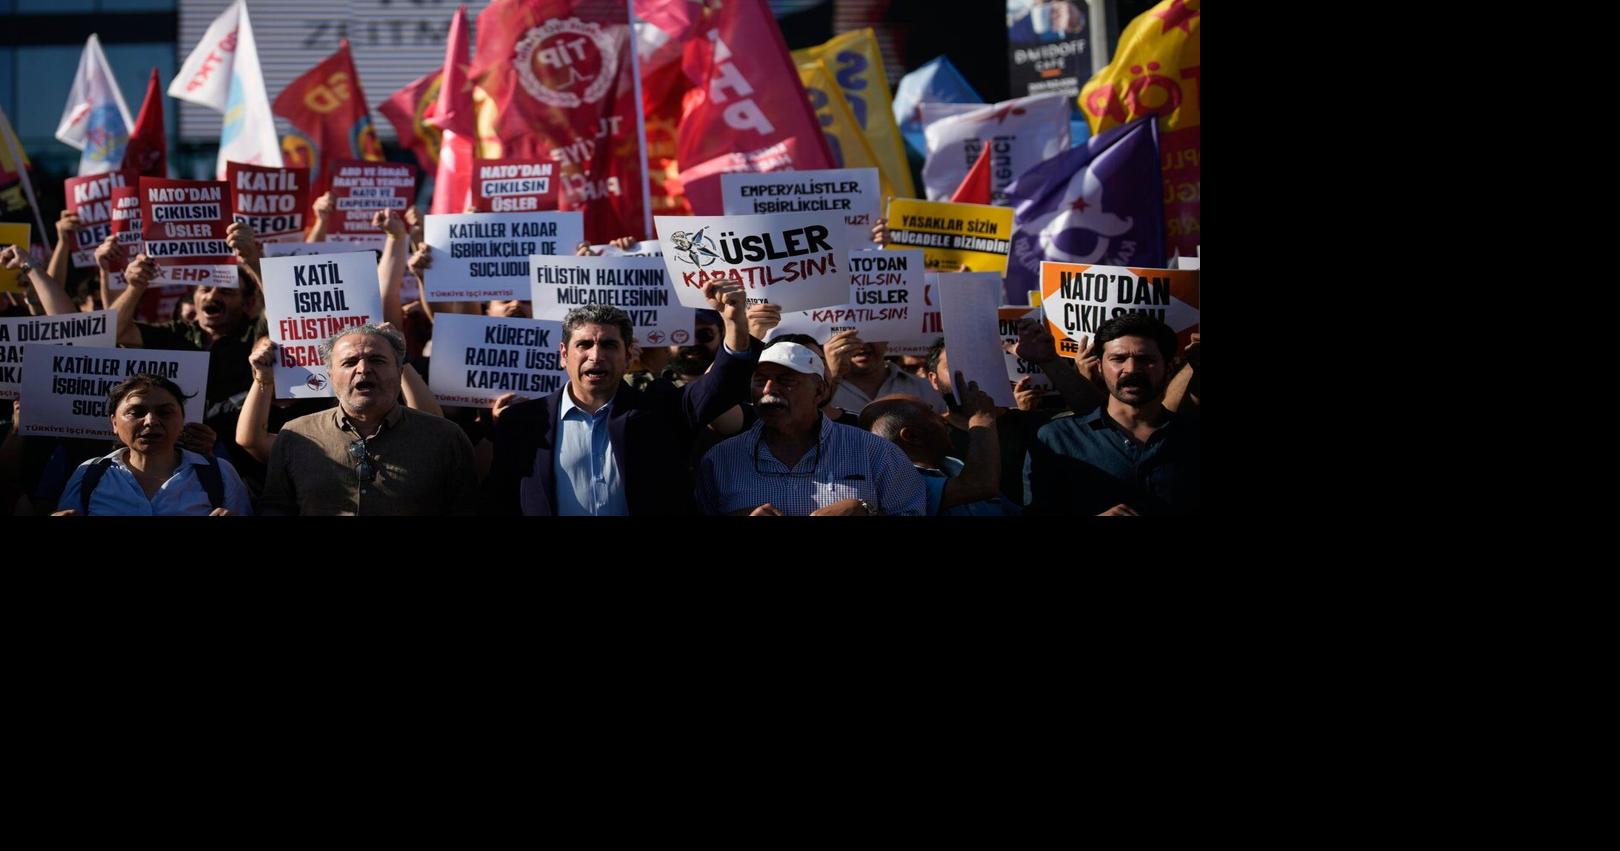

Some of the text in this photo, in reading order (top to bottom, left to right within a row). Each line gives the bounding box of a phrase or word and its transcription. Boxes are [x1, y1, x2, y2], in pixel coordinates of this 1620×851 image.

[236, 170, 298, 192] KATİL
[480, 164, 552, 179] NATO'DAN
[148, 186, 222, 203] NATO'DAN
[485, 180, 545, 195] ÇIKILSIN
[741, 179, 862, 197] EMPERYALİSTLER,
[77, 201, 112, 224] NAT
[238, 193, 296, 213] NATO
[492, 197, 538, 212] ÜSLER
[154, 205, 219, 222] ÇIKILSIN
[165, 223, 212, 238] ÜSLER
[450, 221, 557, 239] KATİLLER KADAR
[903, 215, 998, 235] YASAKLAR SİZİN
[451, 240, 557, 259] İŞBİRLİKÇİLER DE
[720, 225, 833, 265] ÜSLER
[891, 230, 951, 247] MÜCADELE
[954, 235, 1009, 253] BİZİMDİR!
[171, 268, 210, 281] EHP
[294, 261, 343, 286] KATİL
[682, 253, 838, 290] KAPATILSIN!
[848, 257, 907, 273] TO'DAN
[537, 265, 664, 286] FİLİSTİN HALKININ
[557, 286, 668, 307] MÜCADELESİNİN
[856, 284, 908, 305] ÜSLER
[1060, 271, 1171, 306] NATO'DAN
[294, 287, 349, 313] İSRAİL
[745, 297, 769, 305] ATO'YA
[812, 306, 908, 323] KAPATILSIN!
[18, 314, 106, 342] DÜZENİNİZİ
[485, 324, 551, 348] KÜRECİK
[53, 355, 179, 379] KATİLLER KADAR
[465, 347, 520, 369] RADAR
[53, 376, 120, 396] İŞBİRLİK
[466, 370, 560, 393] KAPATILSIN!
[73, 400, 109, 417] SUÇL
[25, 423, 64, 433] TÜRKİYE
[85, 428, 119, 437] PARTİ
